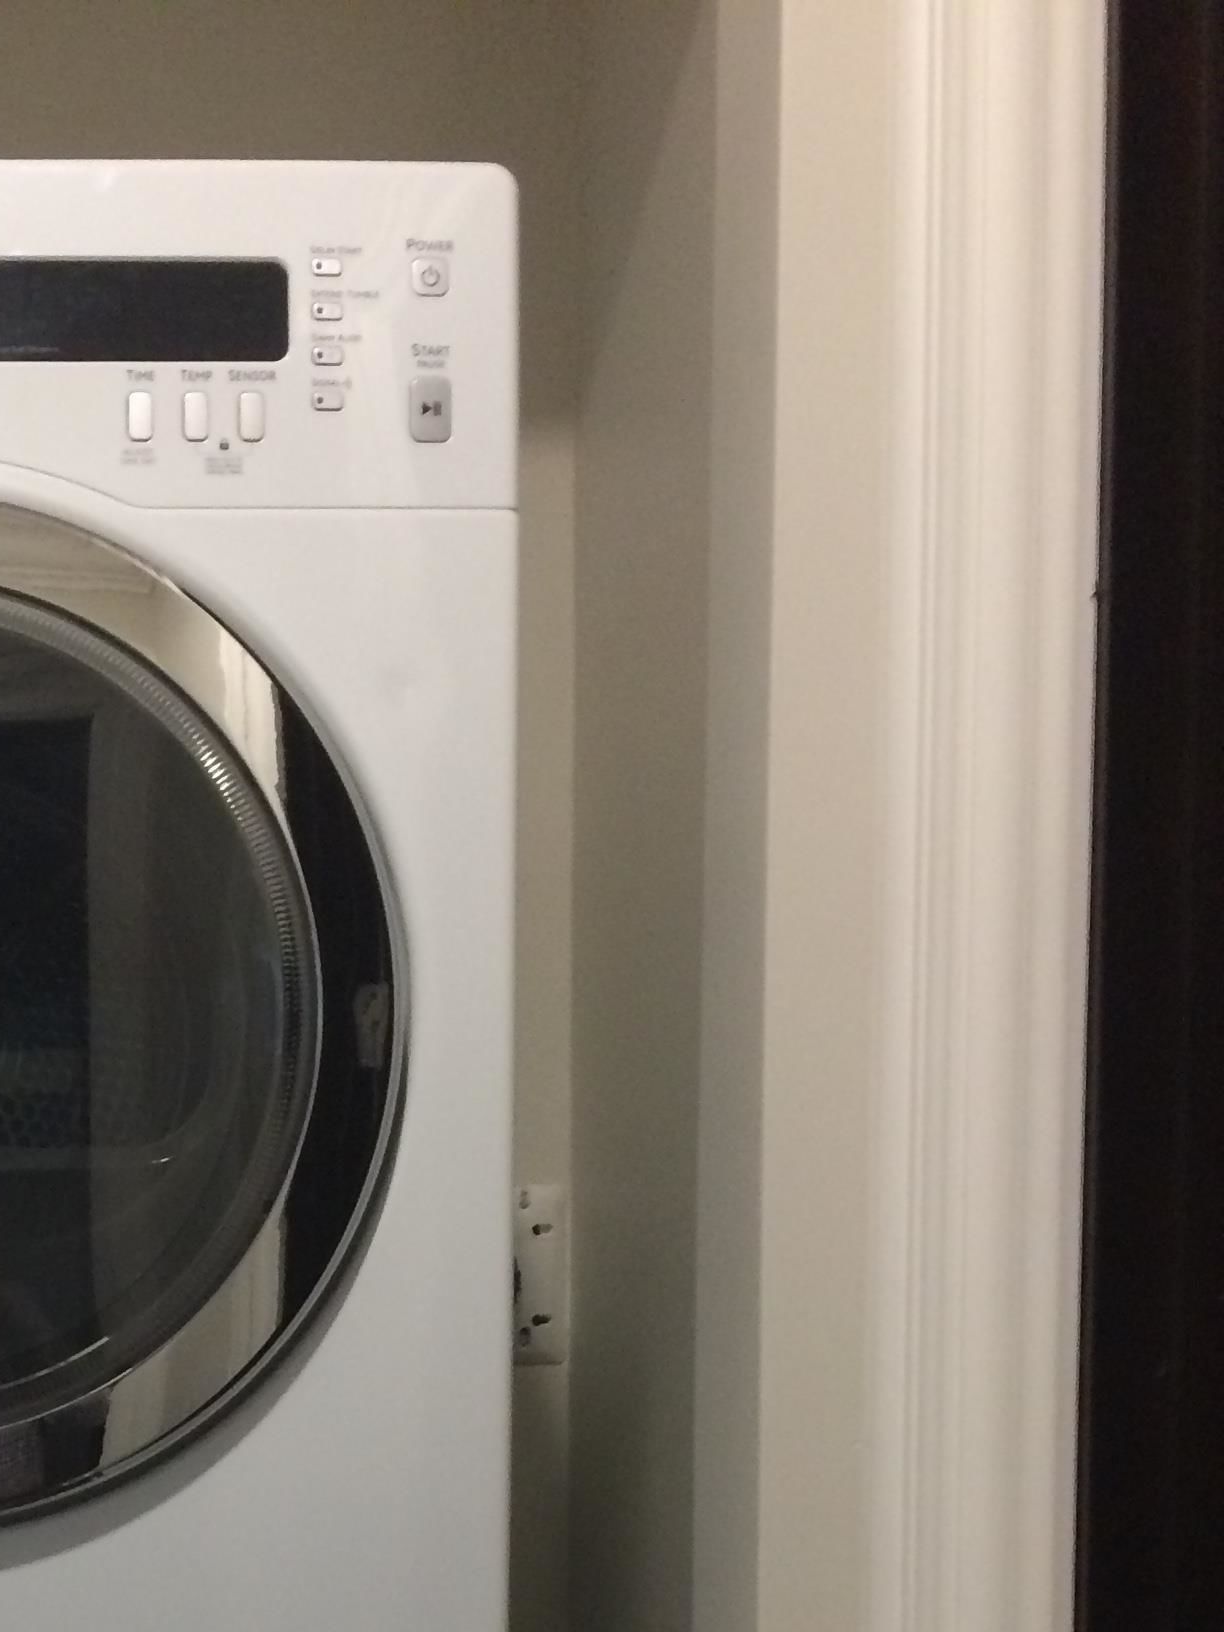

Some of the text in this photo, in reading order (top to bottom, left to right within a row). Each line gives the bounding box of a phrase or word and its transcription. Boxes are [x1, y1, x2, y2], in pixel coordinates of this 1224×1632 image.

[406, 239, 454, 252] POWER
[411, 343, 451, 357] START
[126, 369, 155, 381] TIME
[181, 369, 213, 381] TEMP
[228, 369, 276, 381] SENSOR
